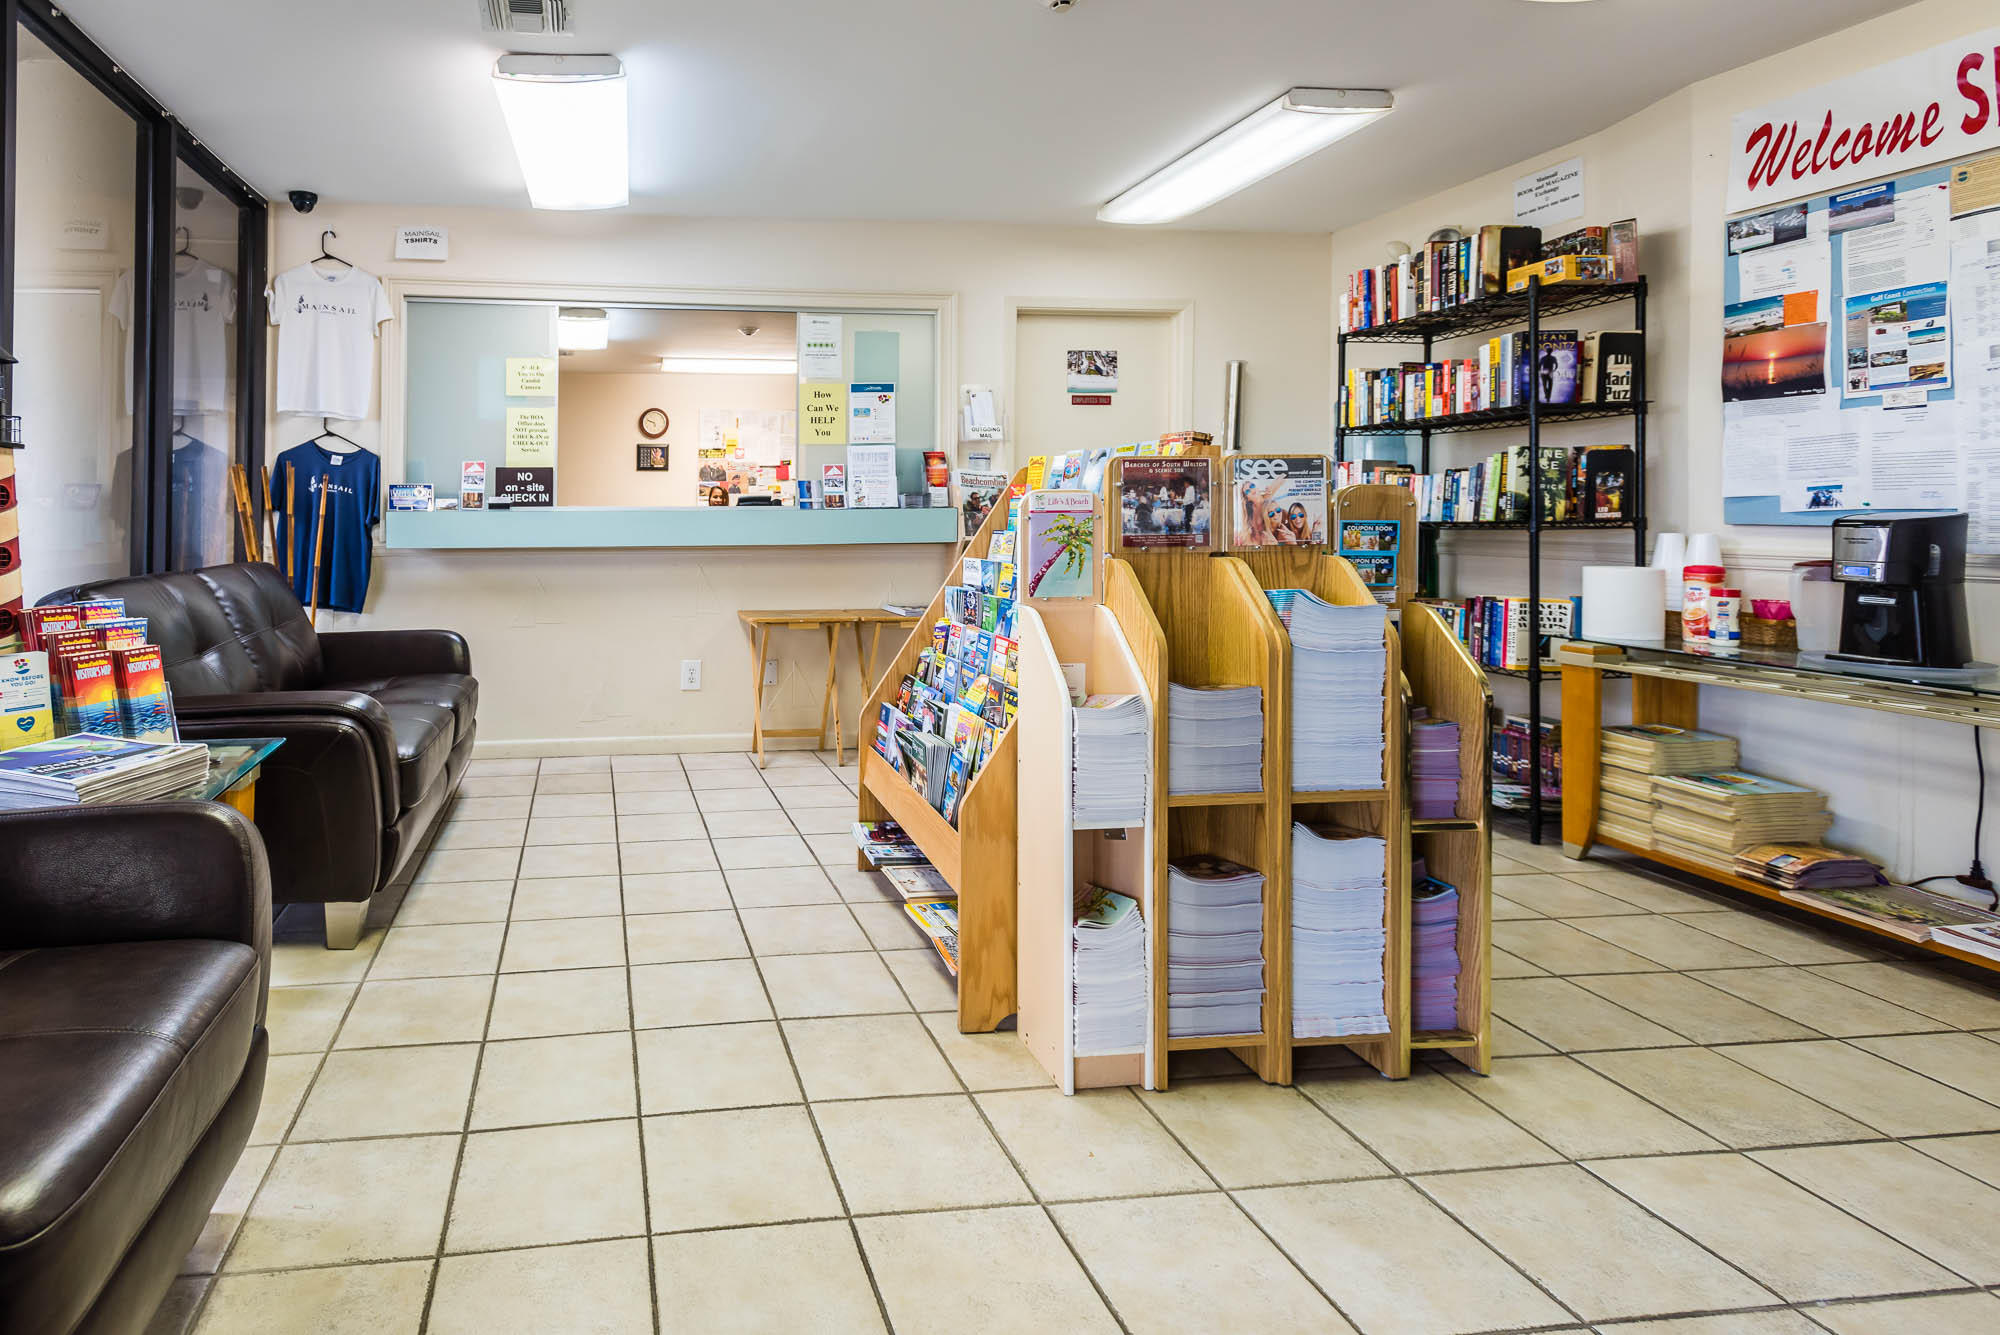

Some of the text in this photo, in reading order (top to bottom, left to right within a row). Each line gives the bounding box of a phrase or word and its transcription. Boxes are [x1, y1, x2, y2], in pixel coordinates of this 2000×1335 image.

[1745, 102, 1944, 192] Welcome
[1956, 45, 2000, 135] S
[302, 304, 358, 314] MAINSAIL
[814, 391, 832, 399] How
[807, 404, 839, 412] Can We
[1240, 459, 1288, 479] see
[518, 472, 533, 481] NO
[314, 483, 352, 494] MANSAIL
[526, 484, 545, 492] site
[539, 494, 549, 502] IN
[1048, 496, 1064, 506] Life's
[1070, 496, 1088, 505] Beach
